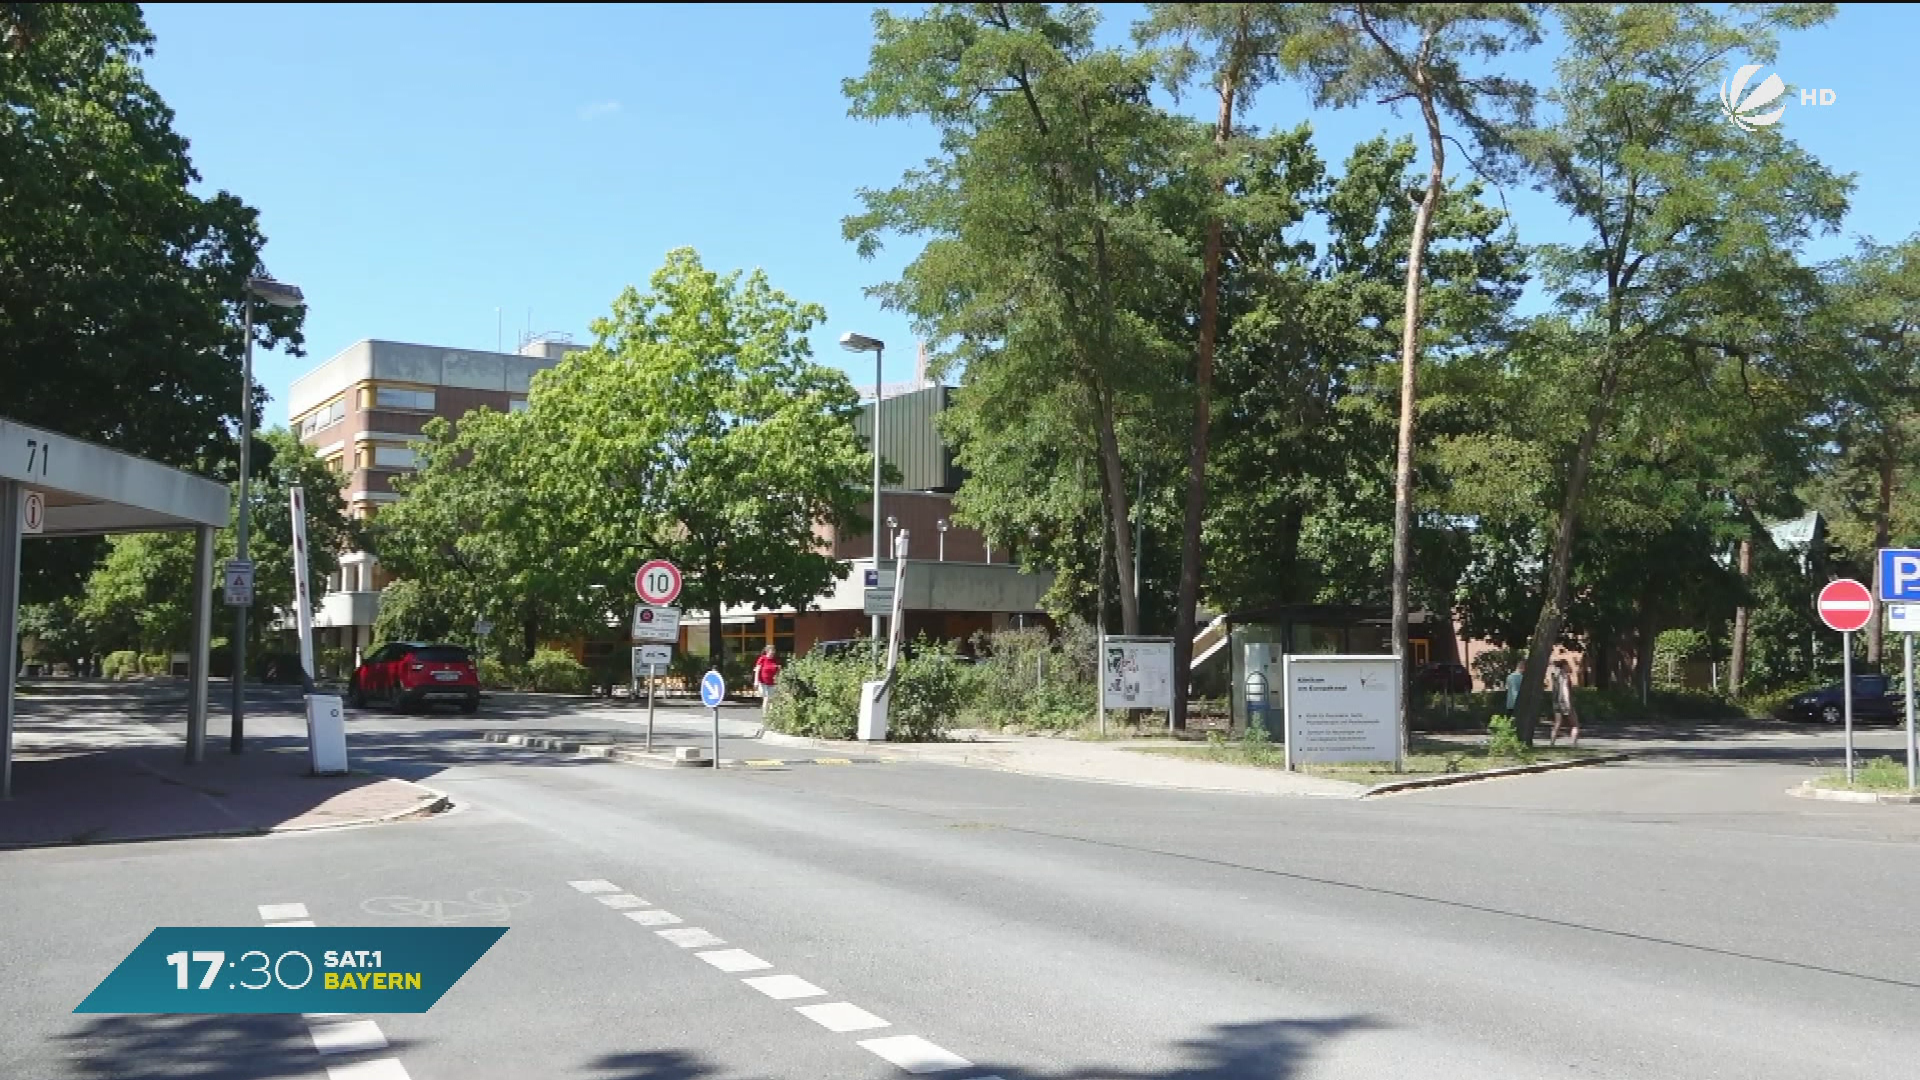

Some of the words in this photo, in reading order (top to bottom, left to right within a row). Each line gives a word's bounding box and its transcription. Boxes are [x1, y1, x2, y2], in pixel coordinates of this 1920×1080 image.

[27, 439, 48, 476] 71
[648, 572, 669, 593] 10
[1894, 557, 1920, 595] P
